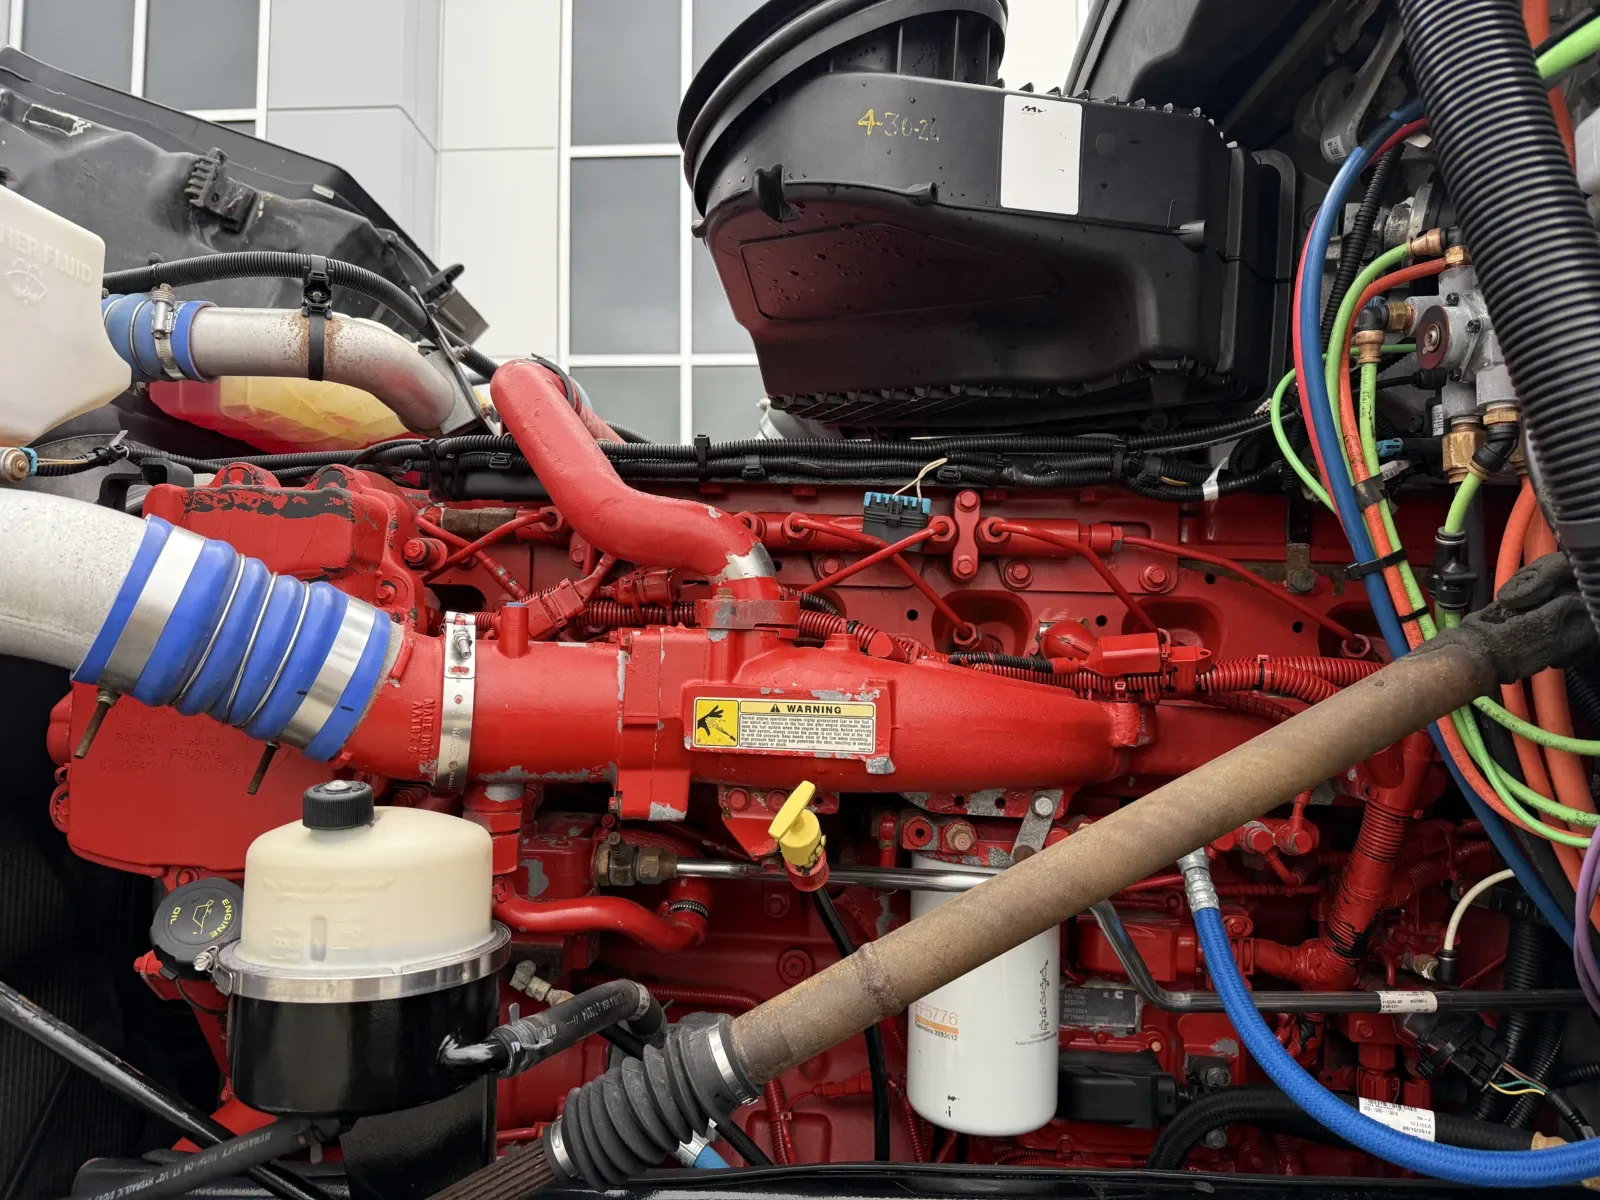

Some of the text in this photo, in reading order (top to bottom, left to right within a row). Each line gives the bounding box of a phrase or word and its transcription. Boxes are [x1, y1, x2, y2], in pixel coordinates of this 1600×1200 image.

[44, 244, 92, 285] FLUID
[787, 704, 842, 715] WARNING
[170, 906, 182, 925] OIL
[209, 898, 232, 938] ENGINE
[222, 1132, 272, 1159] DYNACRAFT
[118, 1176, 154, 1197] HYDRAULIC
